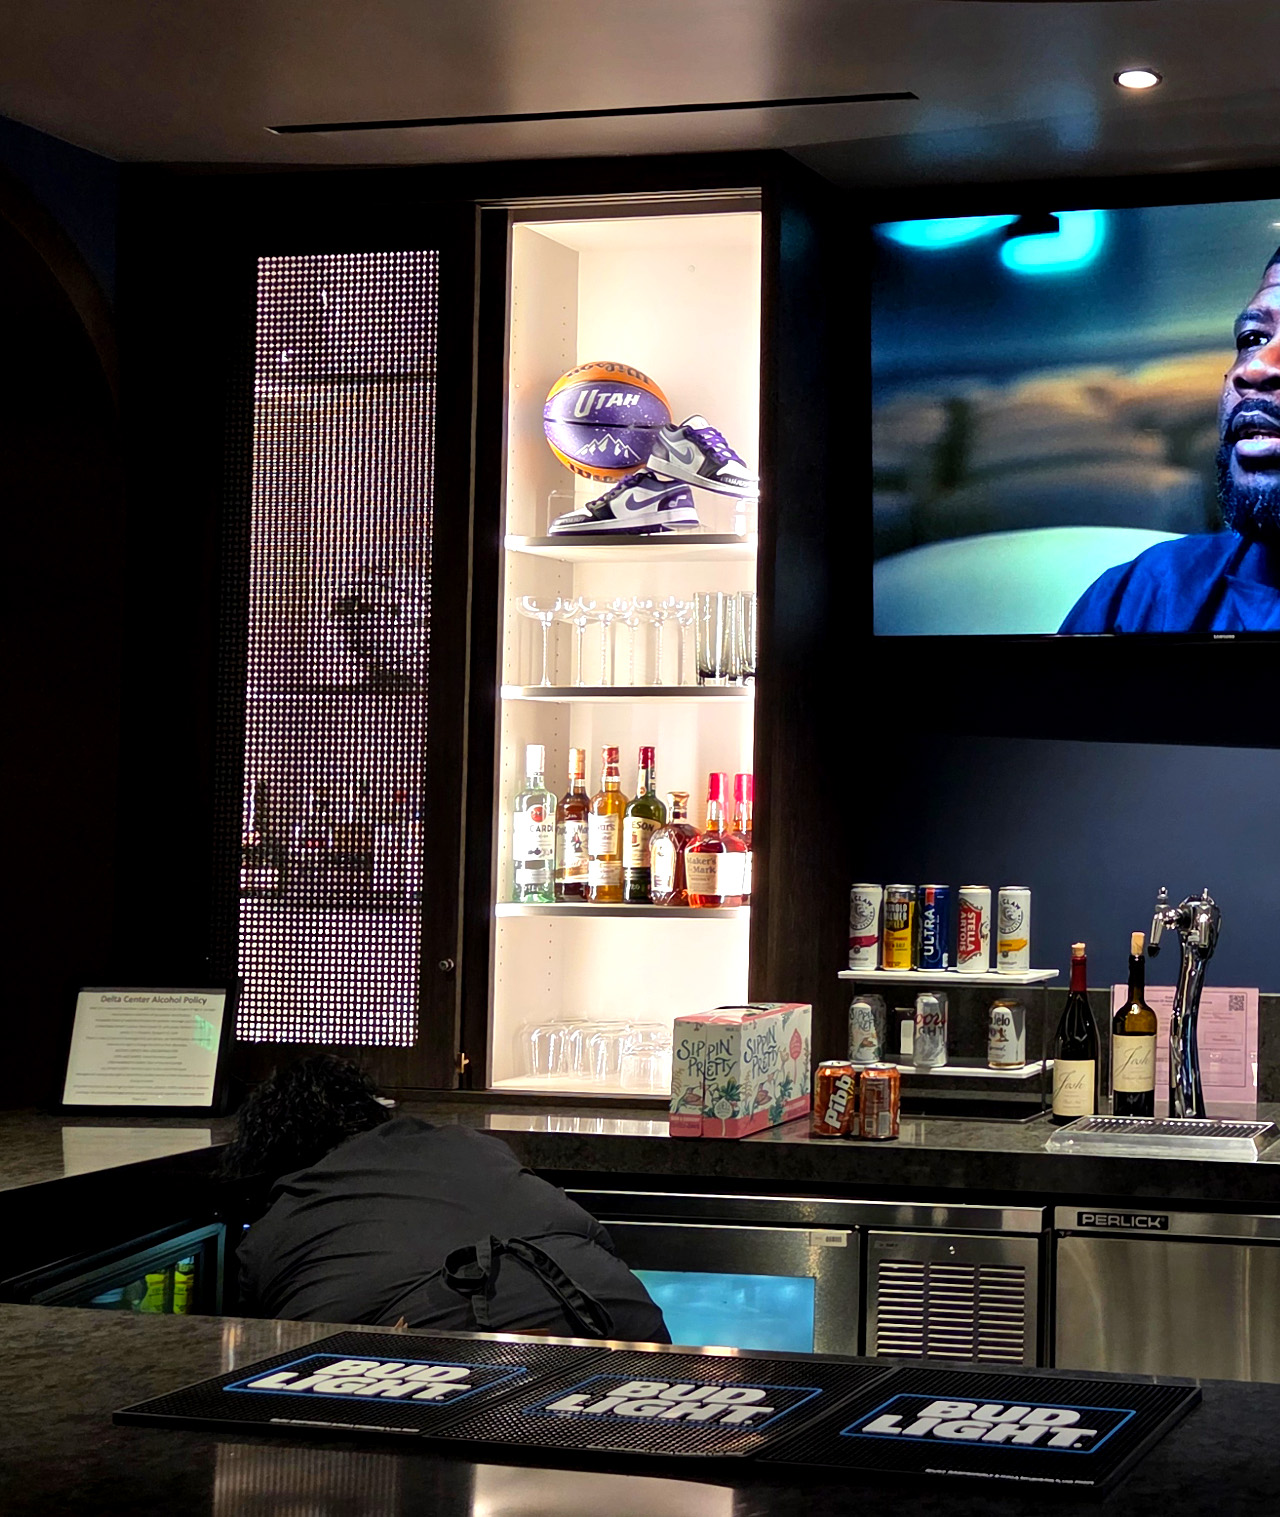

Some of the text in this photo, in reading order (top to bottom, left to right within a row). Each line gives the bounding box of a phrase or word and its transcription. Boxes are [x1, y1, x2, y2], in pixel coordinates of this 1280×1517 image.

[574, 389, 640, 418] UTAH
[923, 908, 935, 956] ULTRA
[966, 911, 976, 951] STELLA
[101, 995, 208, 1006] Delta Center Alcohol Policy
[914, 1012, 947, 1026] oors
[918, 1025, 944, 1037] GHT
[688, 1056, 738, 1081] PRETTY
[1082, 1213, 1161, 1229] PERLICK
[312, 1359, 471, 1382] BUD
[606, 1380, 767, 1405] BUD
[916, 1400, 1082, 1427] BUD
